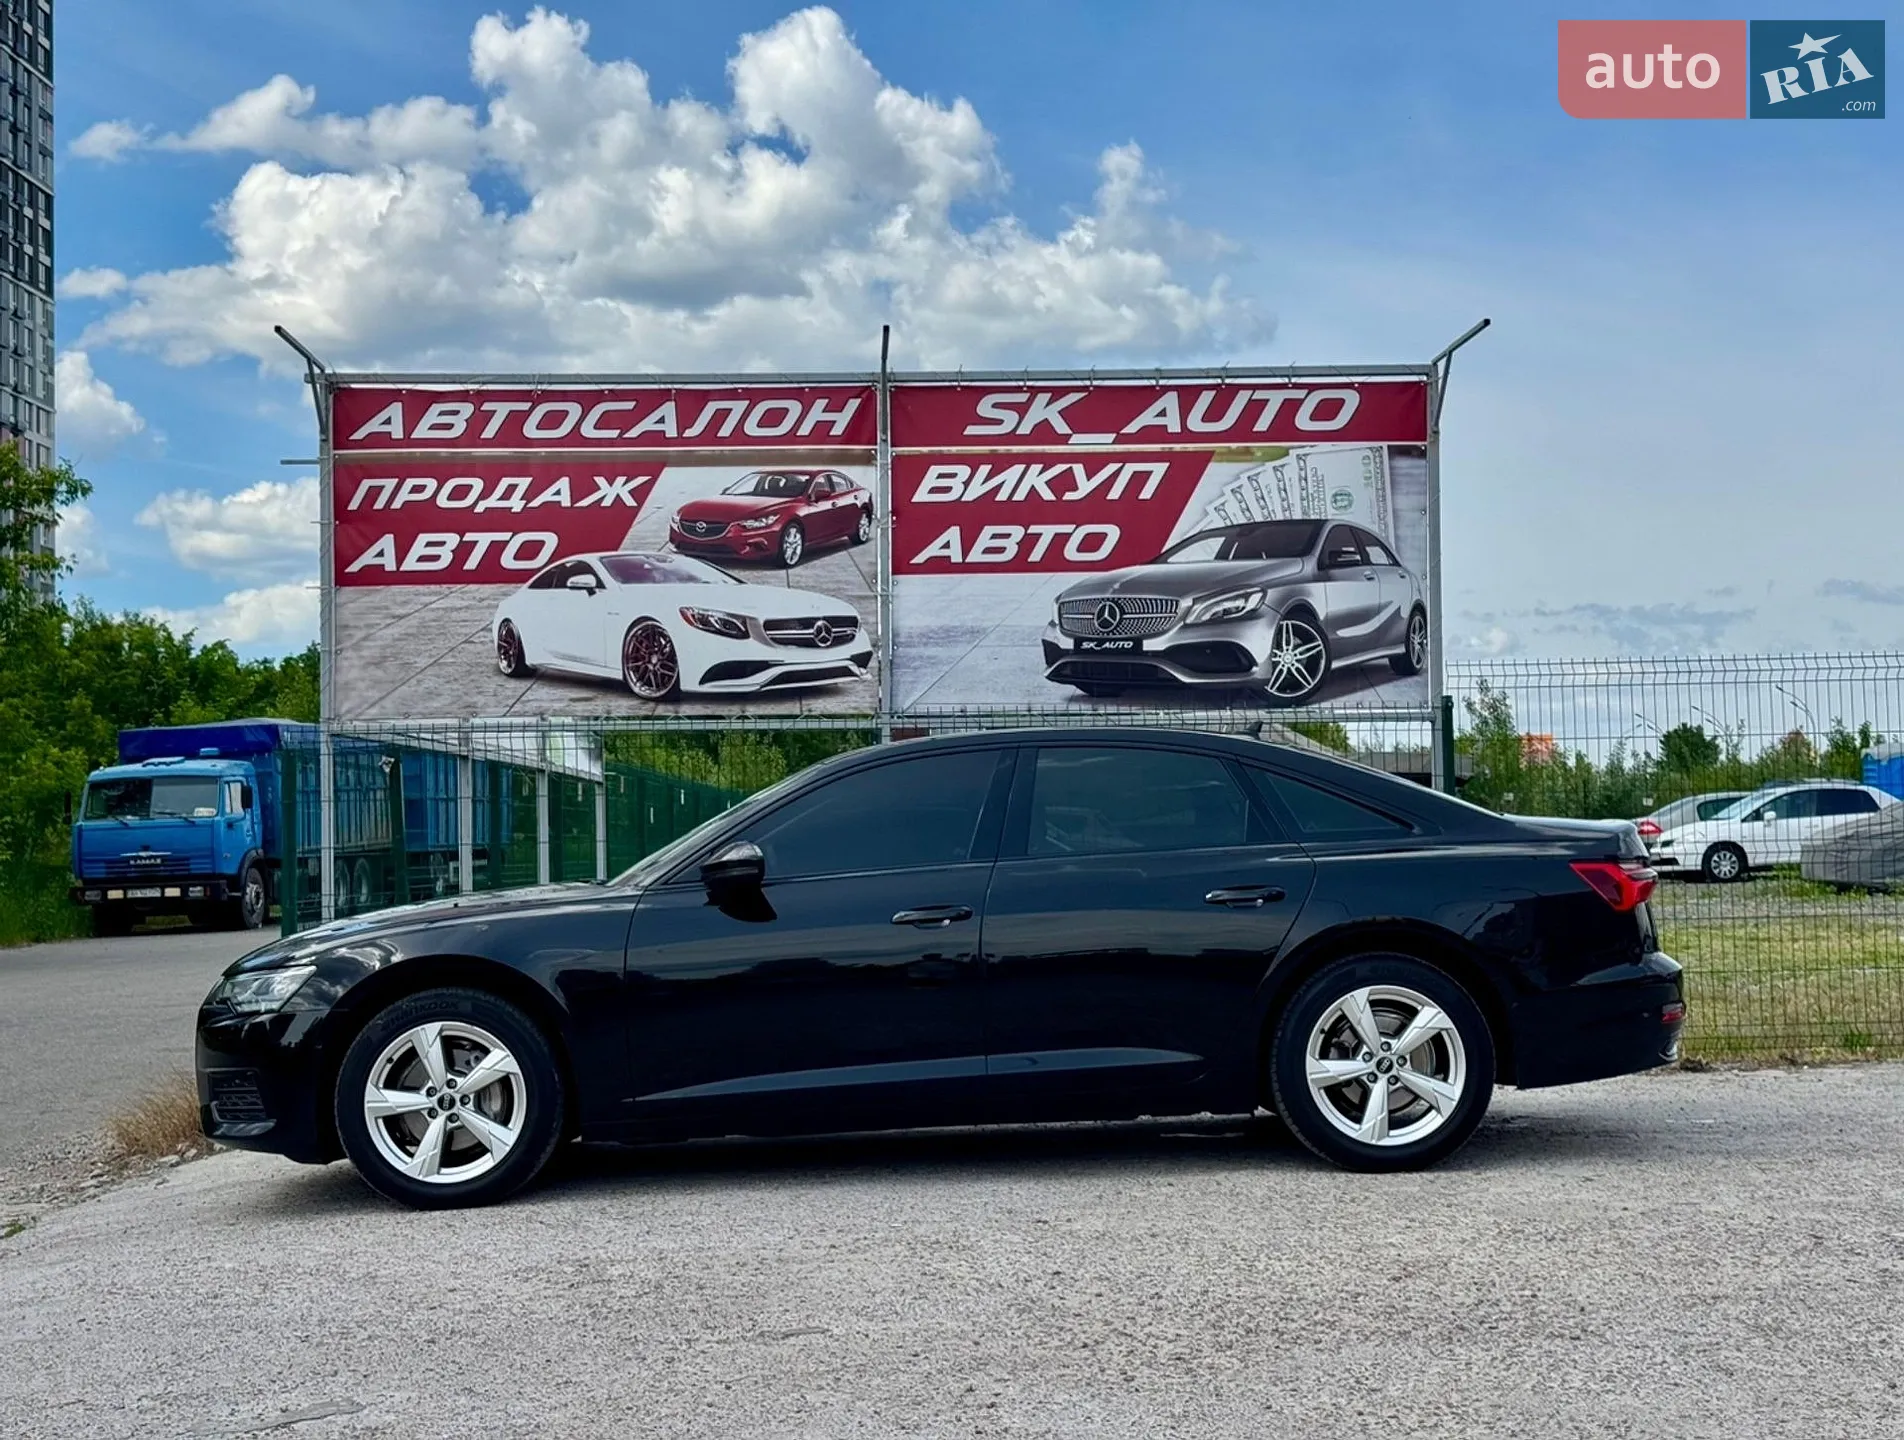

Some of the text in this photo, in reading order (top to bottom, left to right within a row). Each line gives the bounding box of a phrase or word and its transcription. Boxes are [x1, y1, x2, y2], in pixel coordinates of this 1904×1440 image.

[348, 398, 862, 441] АВТОСАЛОН
[963, 388, 1361, 444] SK_AUTO
[347, 475, 653, 513] ПРОДАЖ
[910, 462, 1170, 503] ВИКУП
[345, 531, 559, 573] АВТО
[909, 523, 1121, 564] АВТО
[1080, 640, 1135, 651] SK_AUTO
